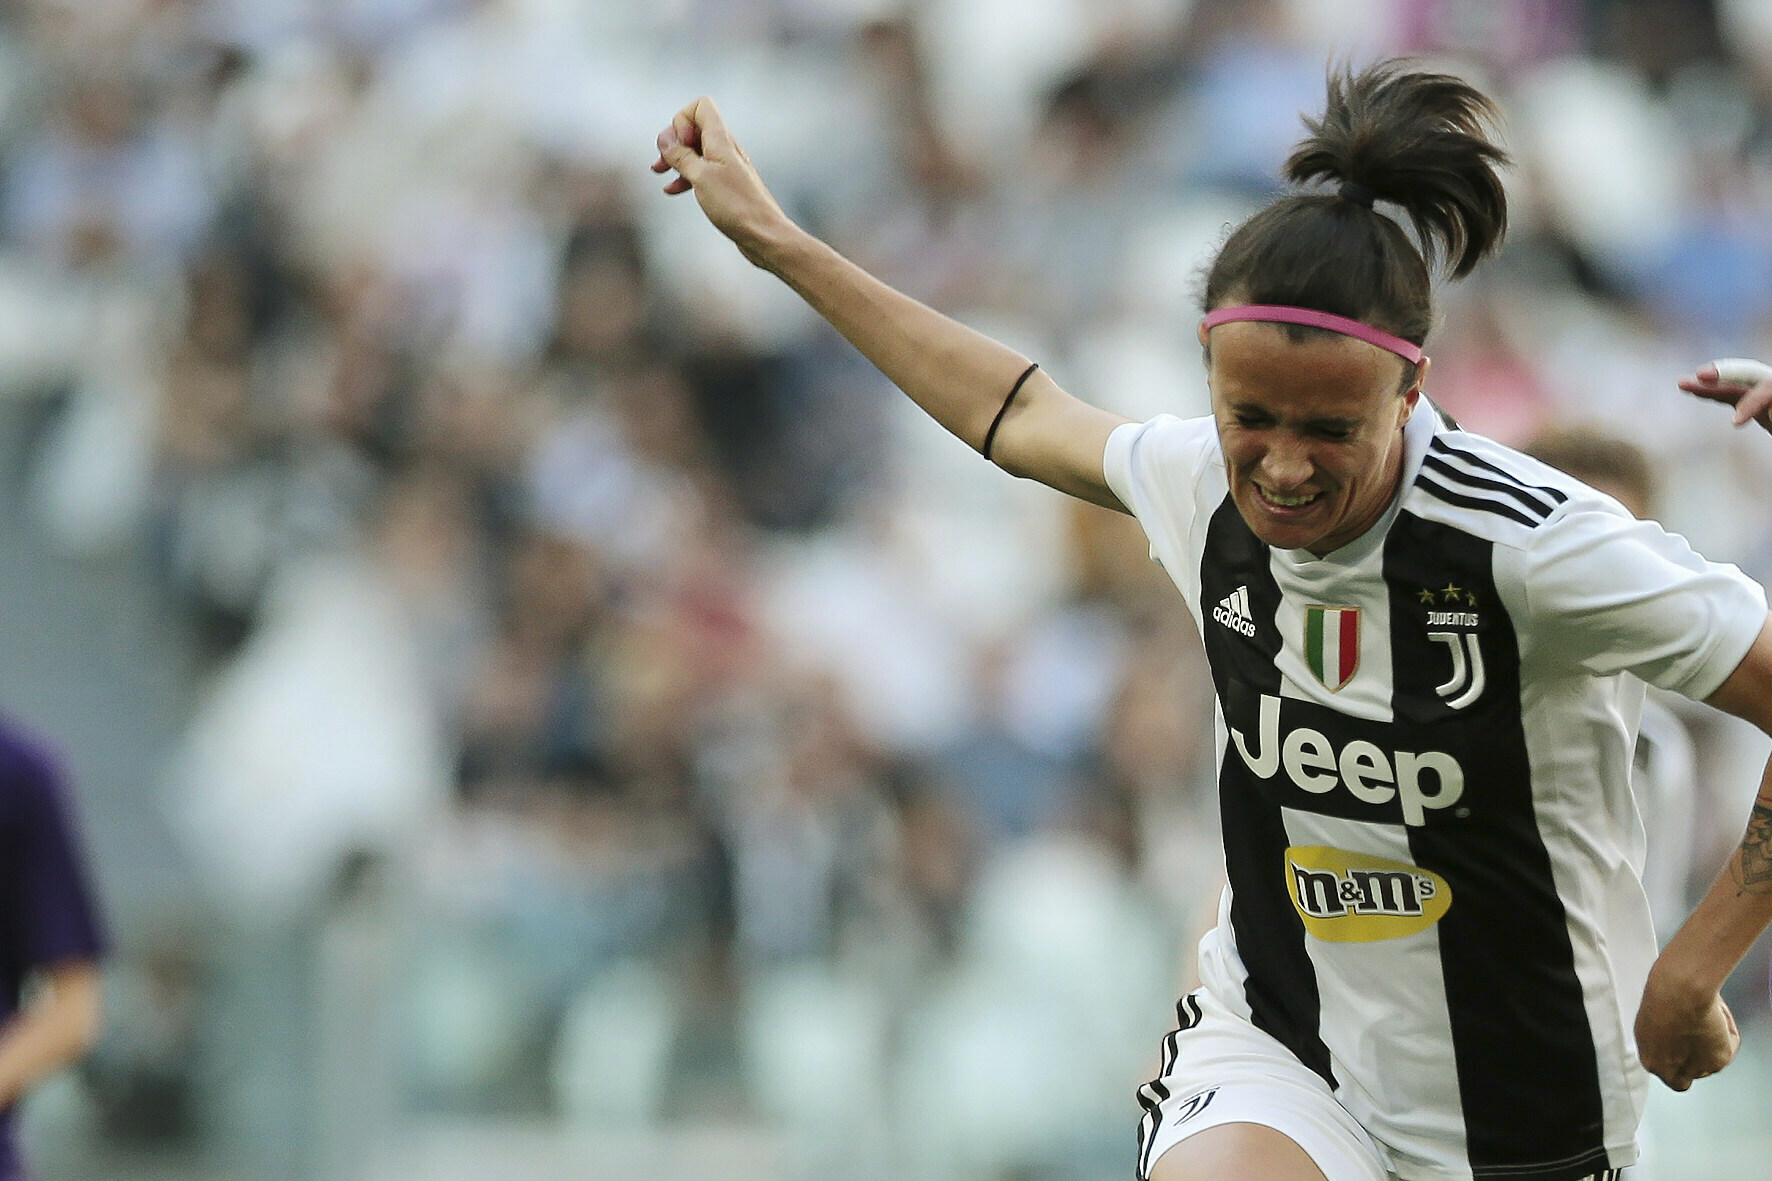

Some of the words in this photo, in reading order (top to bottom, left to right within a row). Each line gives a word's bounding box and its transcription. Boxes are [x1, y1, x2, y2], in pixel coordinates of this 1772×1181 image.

[1212, 606, 1257, 638] adidas
[1427, 611, 1480, 627] JUVENTUS
[1230, 693, 1465, 827] Jeep
